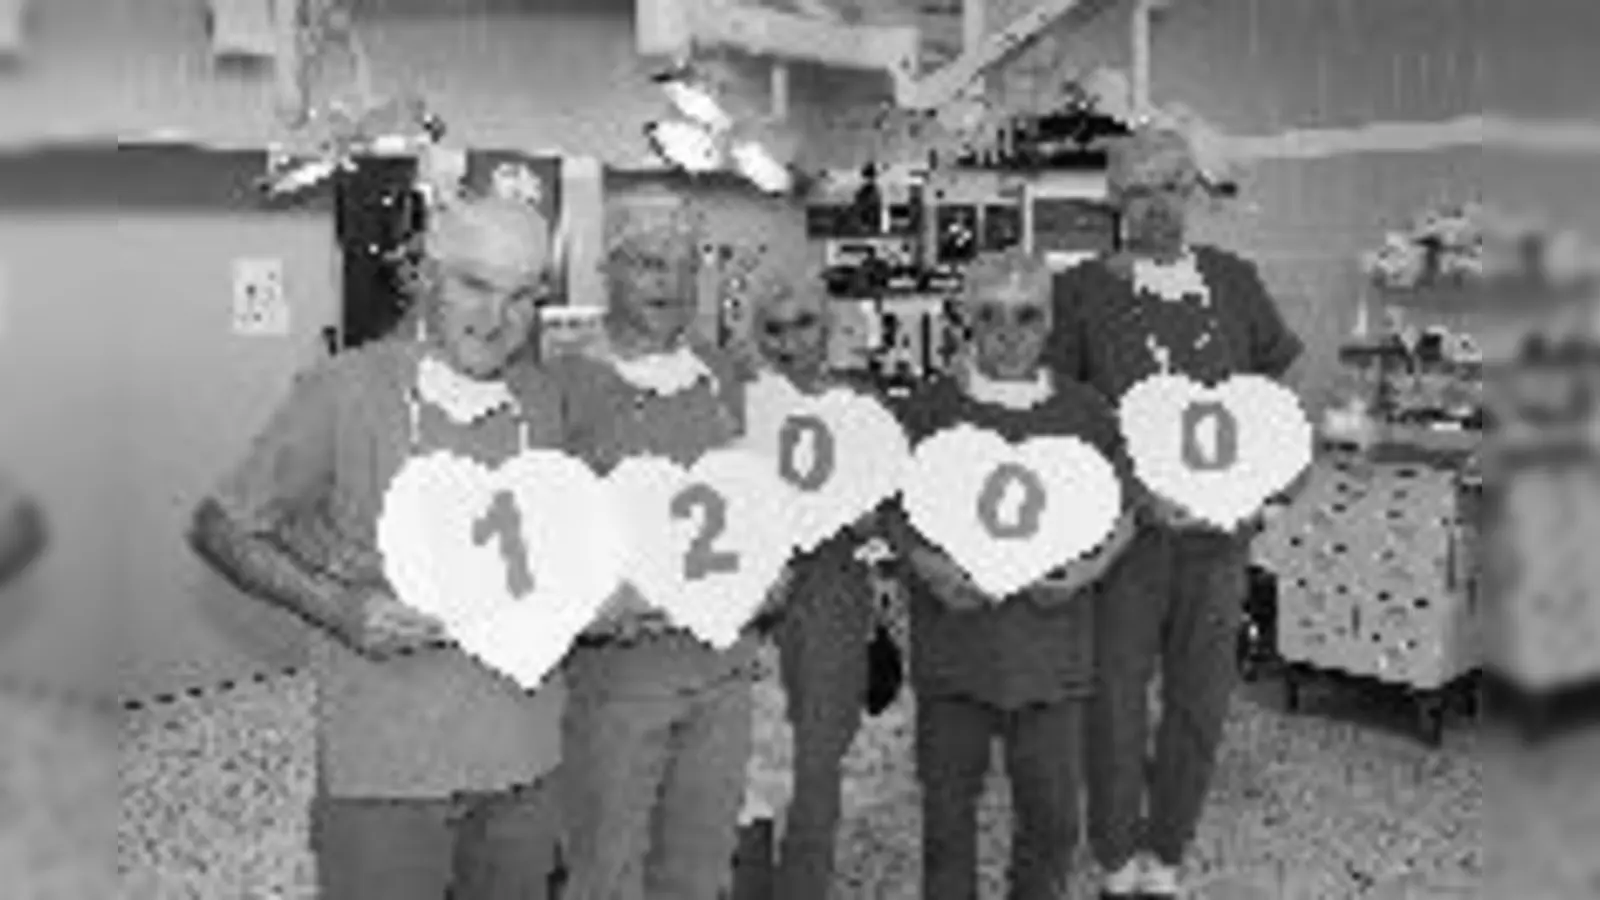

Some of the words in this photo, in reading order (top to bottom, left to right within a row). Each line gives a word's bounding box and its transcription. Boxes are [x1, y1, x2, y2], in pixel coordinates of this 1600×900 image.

[777, 414, 835, 492] 0
[1181, 401, 1238, 471] 0
[670, 483, 739, 581] 2
[977, 463, 1046, 539] 0
[473, 491, 533, 598] 1
